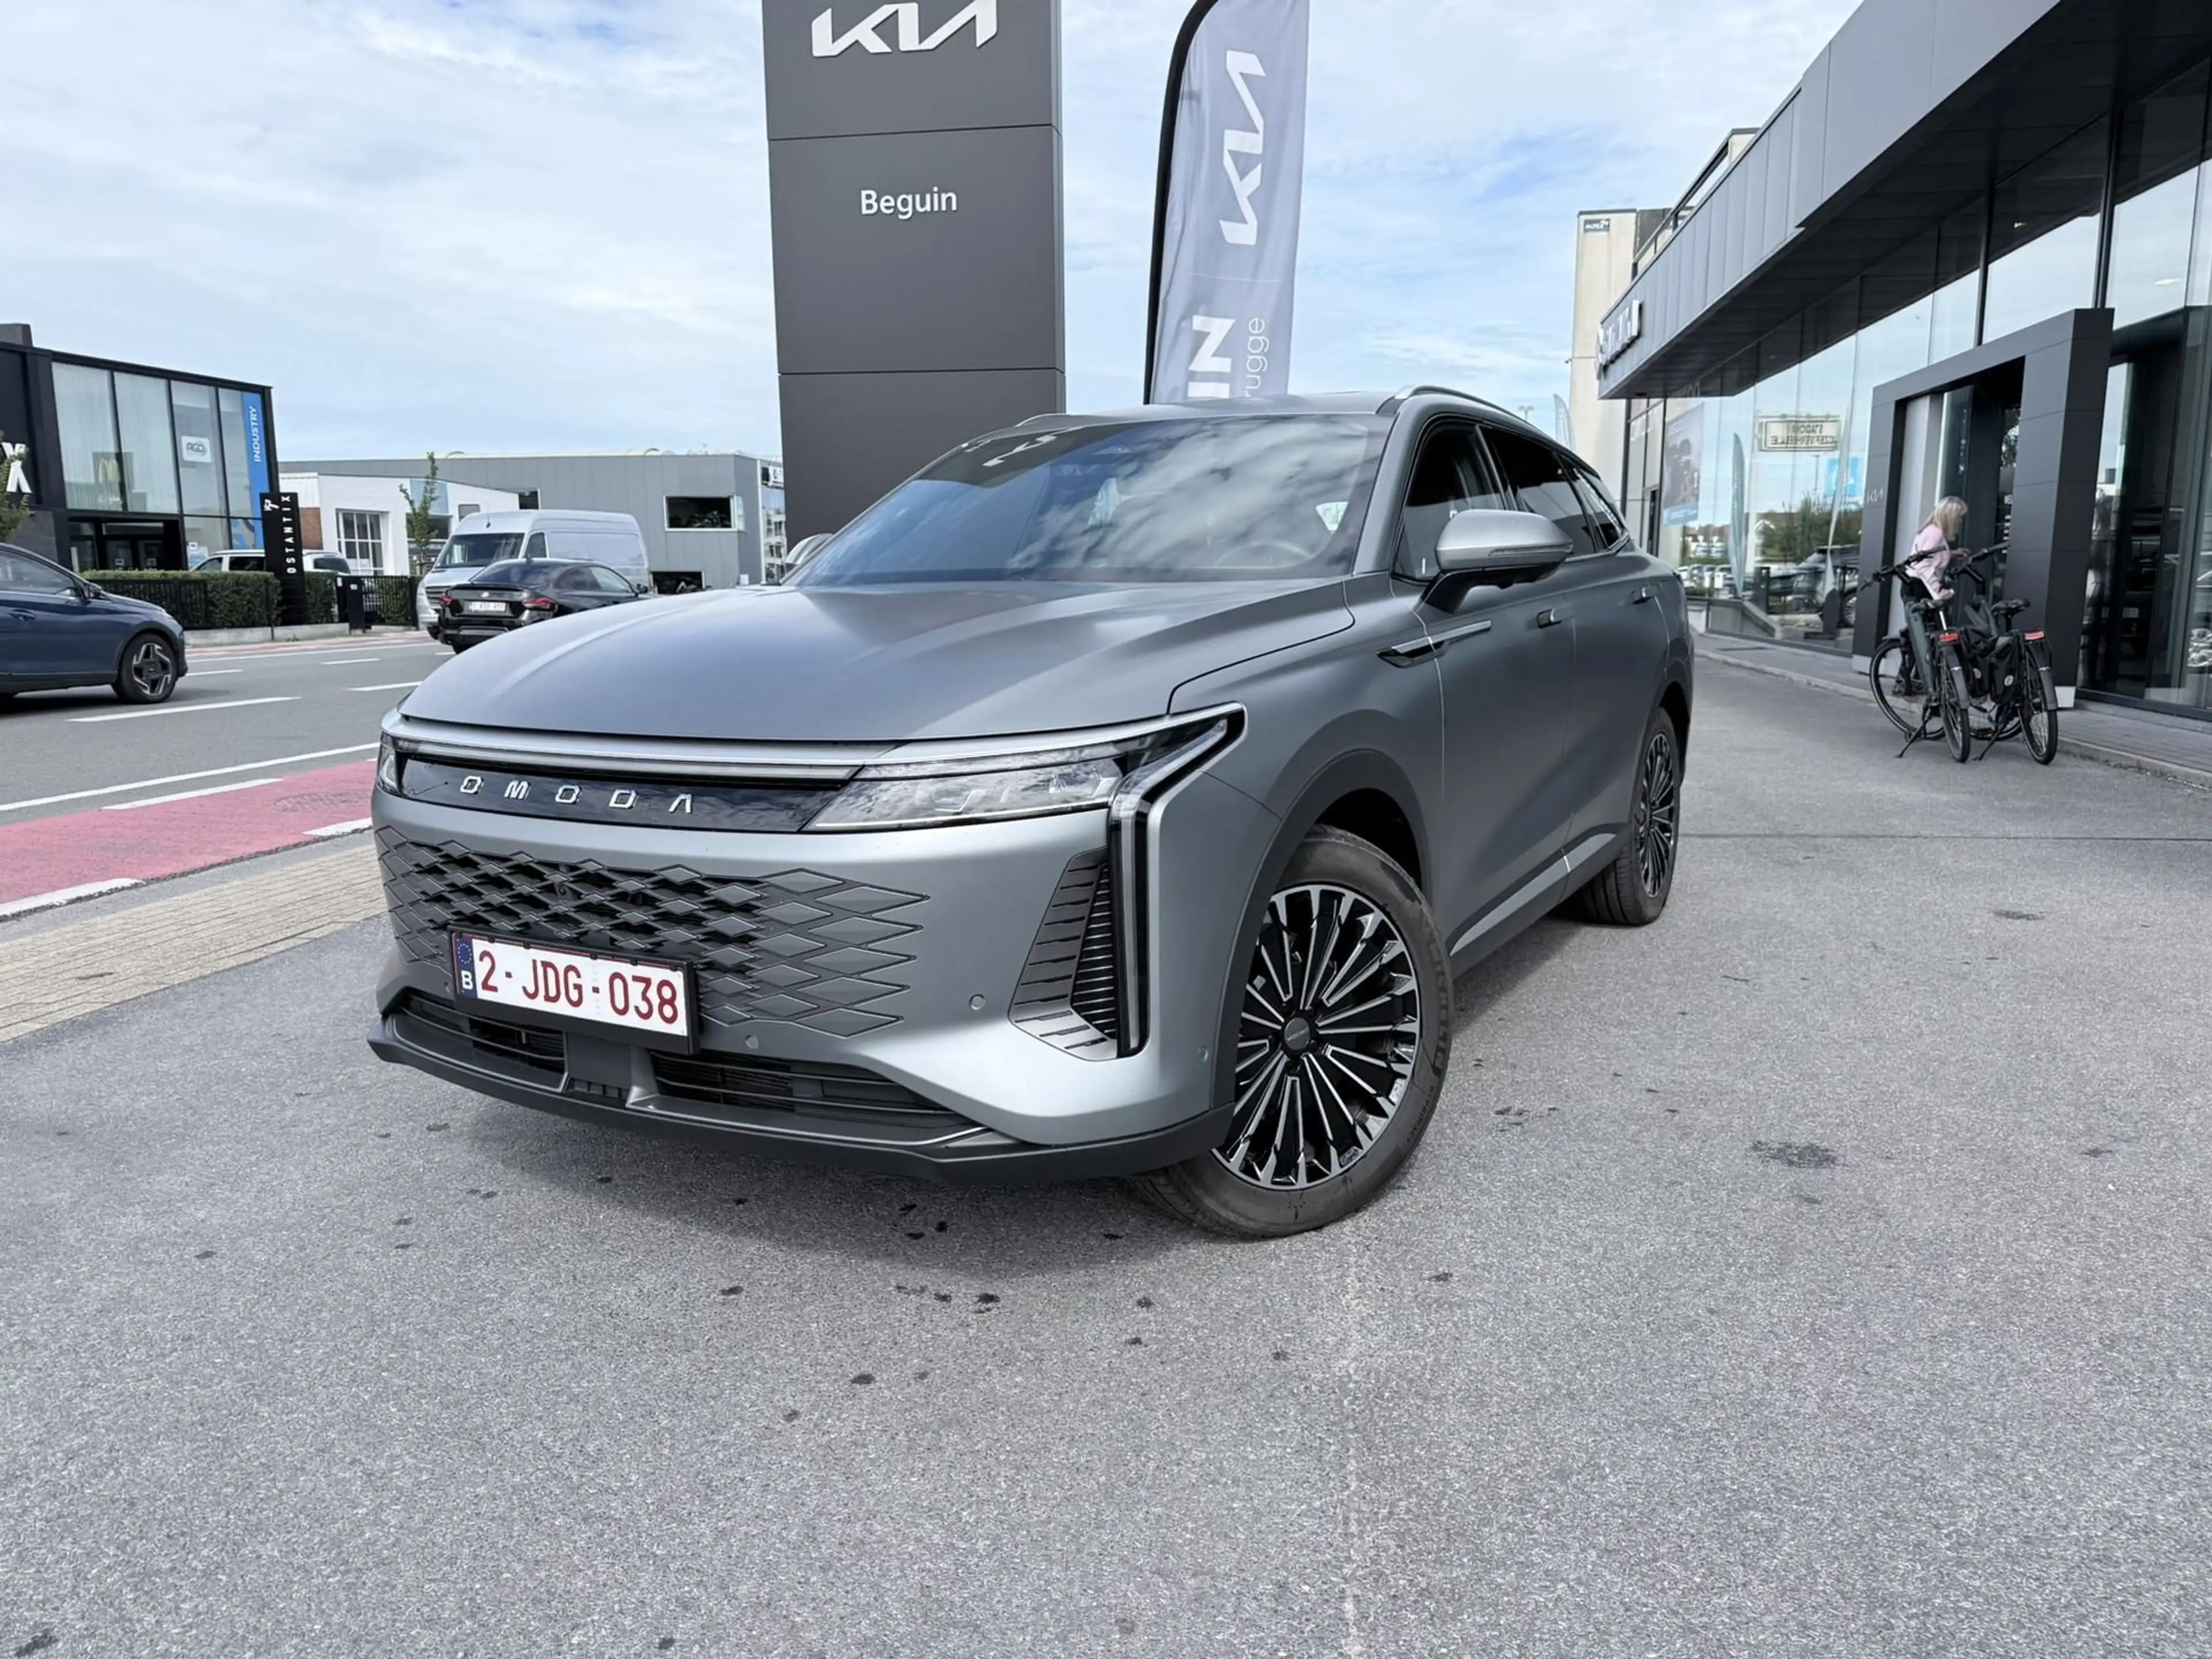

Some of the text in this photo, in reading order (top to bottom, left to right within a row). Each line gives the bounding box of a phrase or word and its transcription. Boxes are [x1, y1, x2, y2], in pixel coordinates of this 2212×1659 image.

[811, 0, 998, 58] KIA
[1218, 50, 1266, 246] KIA
[860, 186, 958, 220] Beguin
[248, 405, 262, 462] INDUSTRY
[281, 495, 297, 574] OSTANTIX
[460, 775, 694, 814] OMODA
[460, 971, 474, 990] B
